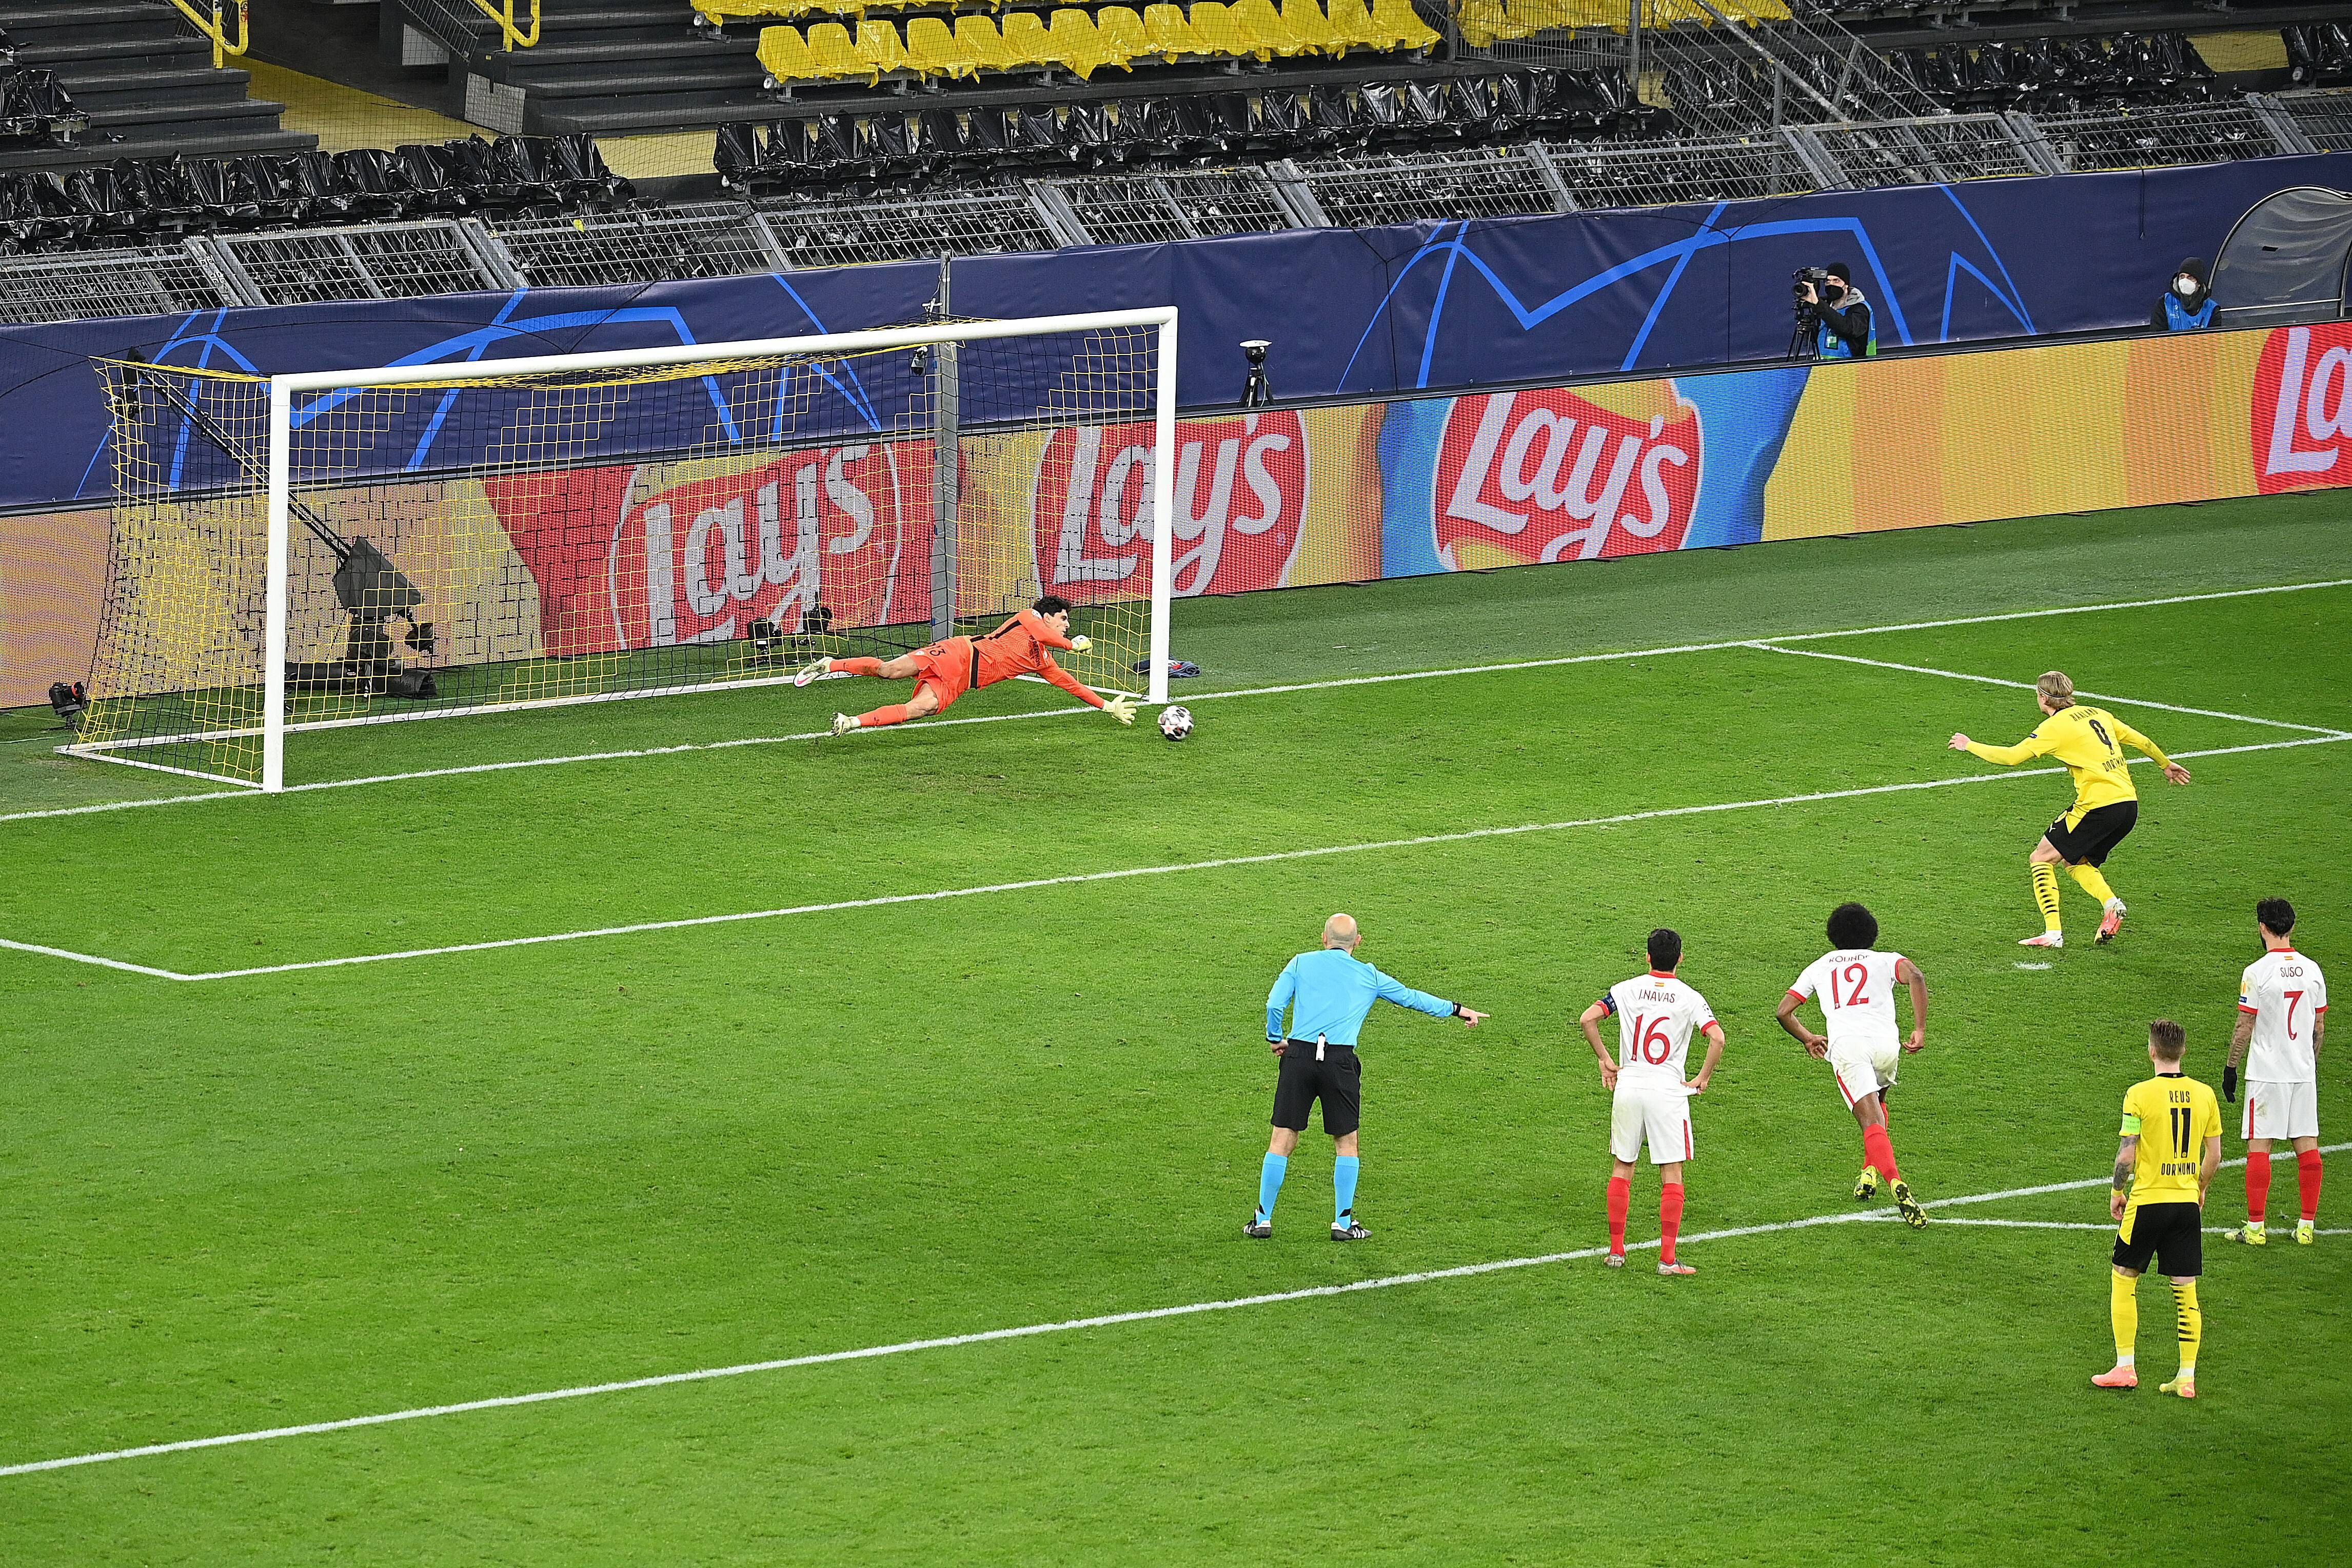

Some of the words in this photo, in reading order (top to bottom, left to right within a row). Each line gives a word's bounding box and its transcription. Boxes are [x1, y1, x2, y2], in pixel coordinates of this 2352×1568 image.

[1446, 392, 1688, 563] Lay's
[2089, 719, 2114, 755] 9
[1831, 963, 1869, 1009] 12
[2280, 966, 2303, 977] SUSO
[2284, 990, 2304, 1040] 7
[1630, 1014, 1670, 1065] 16
[2169, 1090, 2190, 1103] REUS
[2170, 1107, 2191, 1159] 11
[2161, 1163, 2196, 1176] DORTMUND
